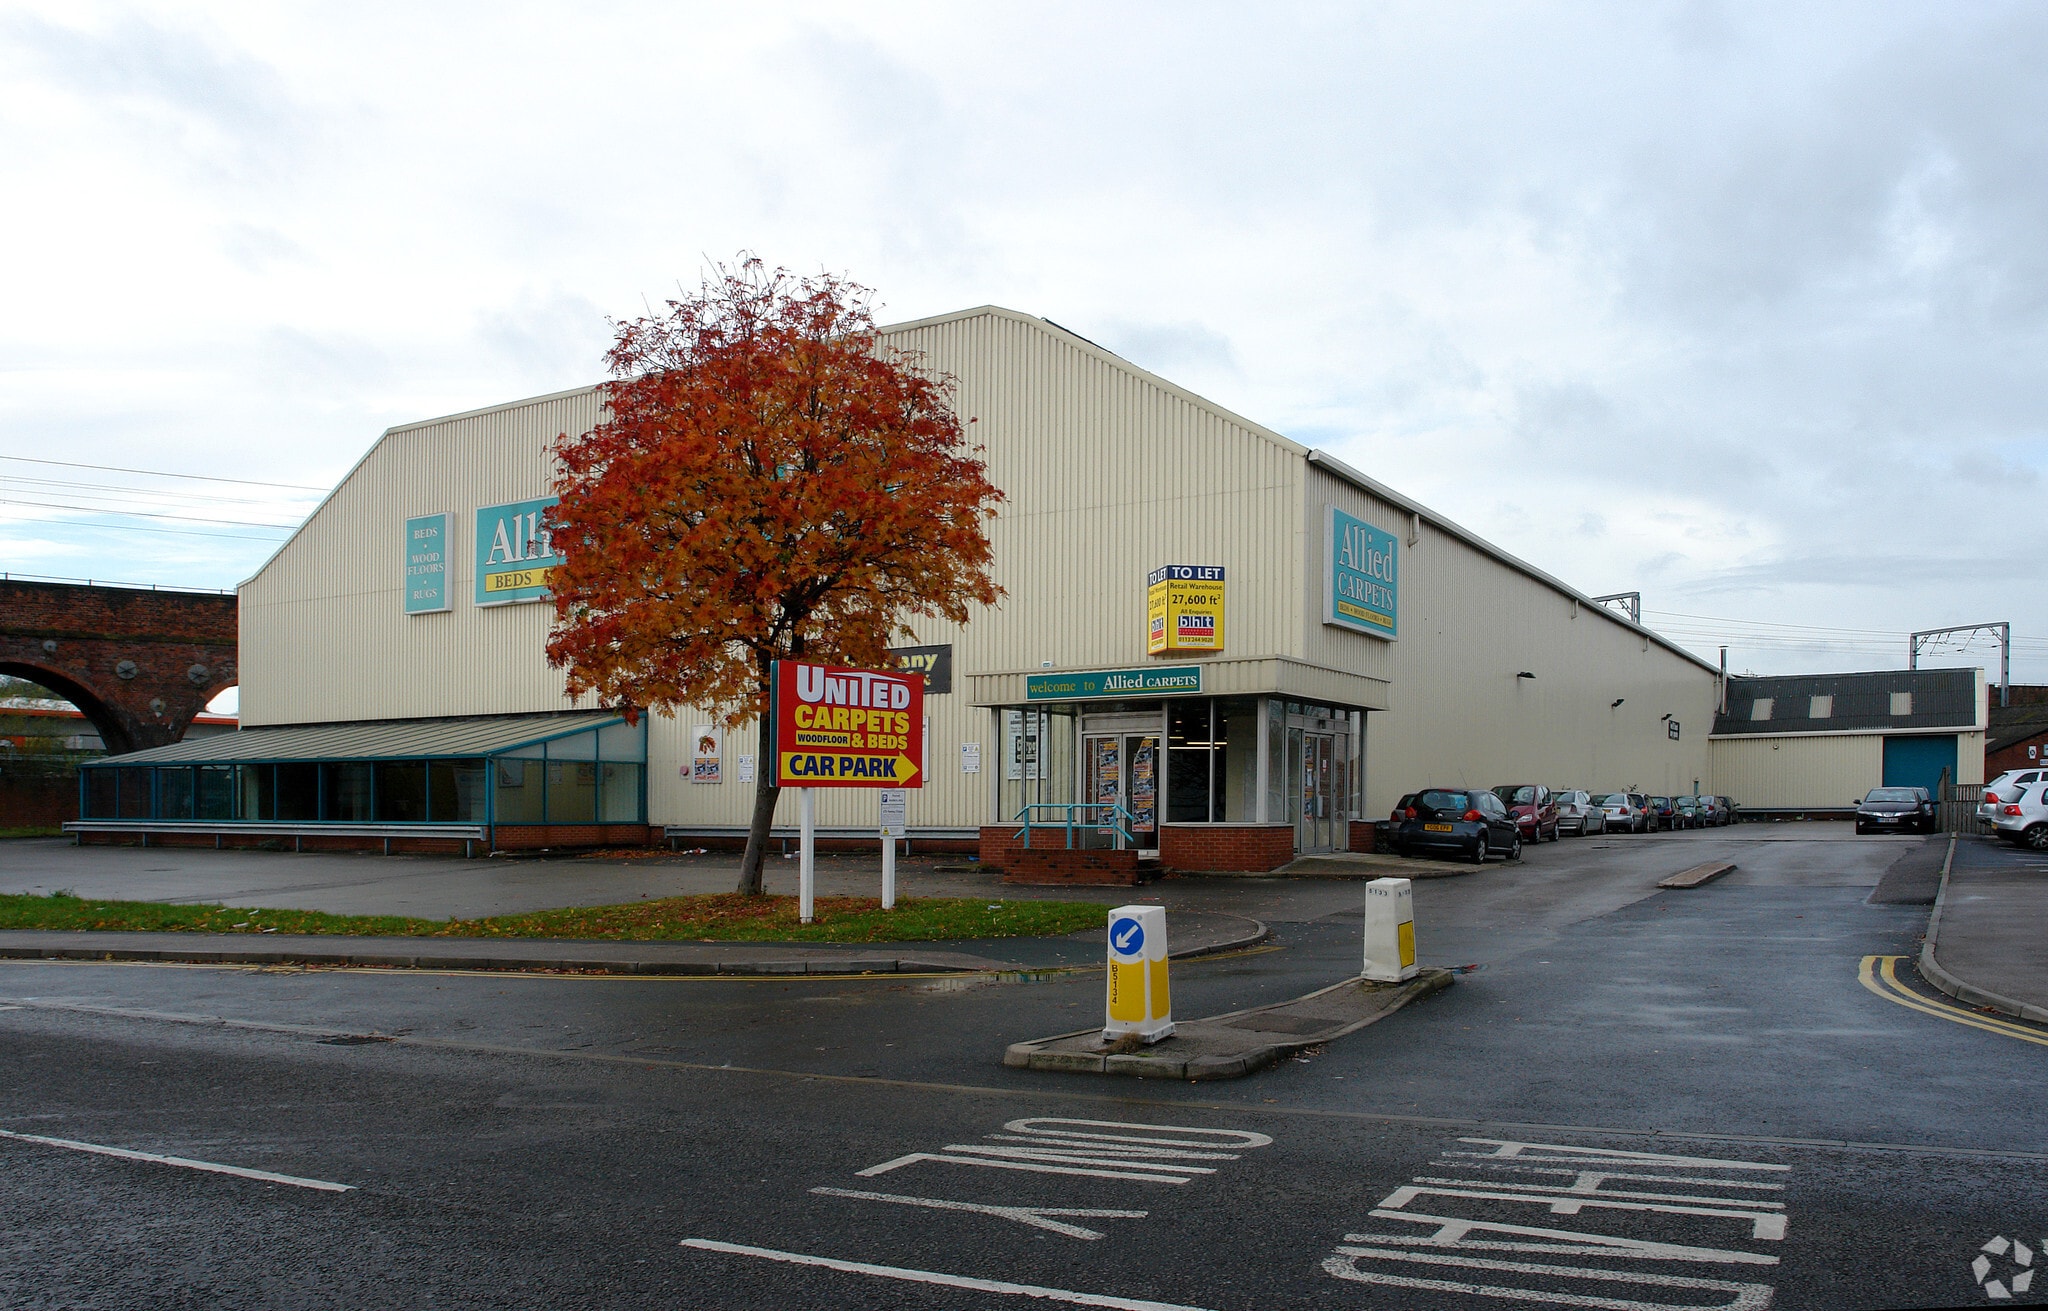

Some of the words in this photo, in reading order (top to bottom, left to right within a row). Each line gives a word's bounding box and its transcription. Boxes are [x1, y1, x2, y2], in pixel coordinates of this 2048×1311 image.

[414, 528, 438, 540] BEDS
[486, 512, 566, 565] Alli
[412, 552, 440, 563] WOOD
[1338, 522, 1393, 582] Allied
[408, 563, 444, 575] FLOORS
[1149, 572, 1156, 585] TO
[1157, 568, 1167, 582] LET
[1172, 567, 1192, 578] TO
[1198, 568, 1220, 579] LET
[495, 572, 532, 588] BEDS
[413, 588, 437, 600] RUGS
[1172, 594, 1206, 605] 27,600
[1338, 572, 1393, 611] CARPETS
[796, 665, 910, 710] UNITED
[1029, 680, 1076, 693] welcome
[1084, 681, 1095, 691] to
[1103, 674, 1143, 690] Allied
[1146, 675, 1197, 688] CARPETS
[794, 704, 910, 734] CARPETS
[797, 733, 848, 744] WOODFLOOR
[851, 732, 864, 748] &
[868, 734, 908, 750] BEDS
[789, 755, 835, 776] CAR
[839, 757, 897, 778] PARK
[807, 1117, 1274, 1240] ONLY
[1321, 1137, 1792, 1311] AHEAD
